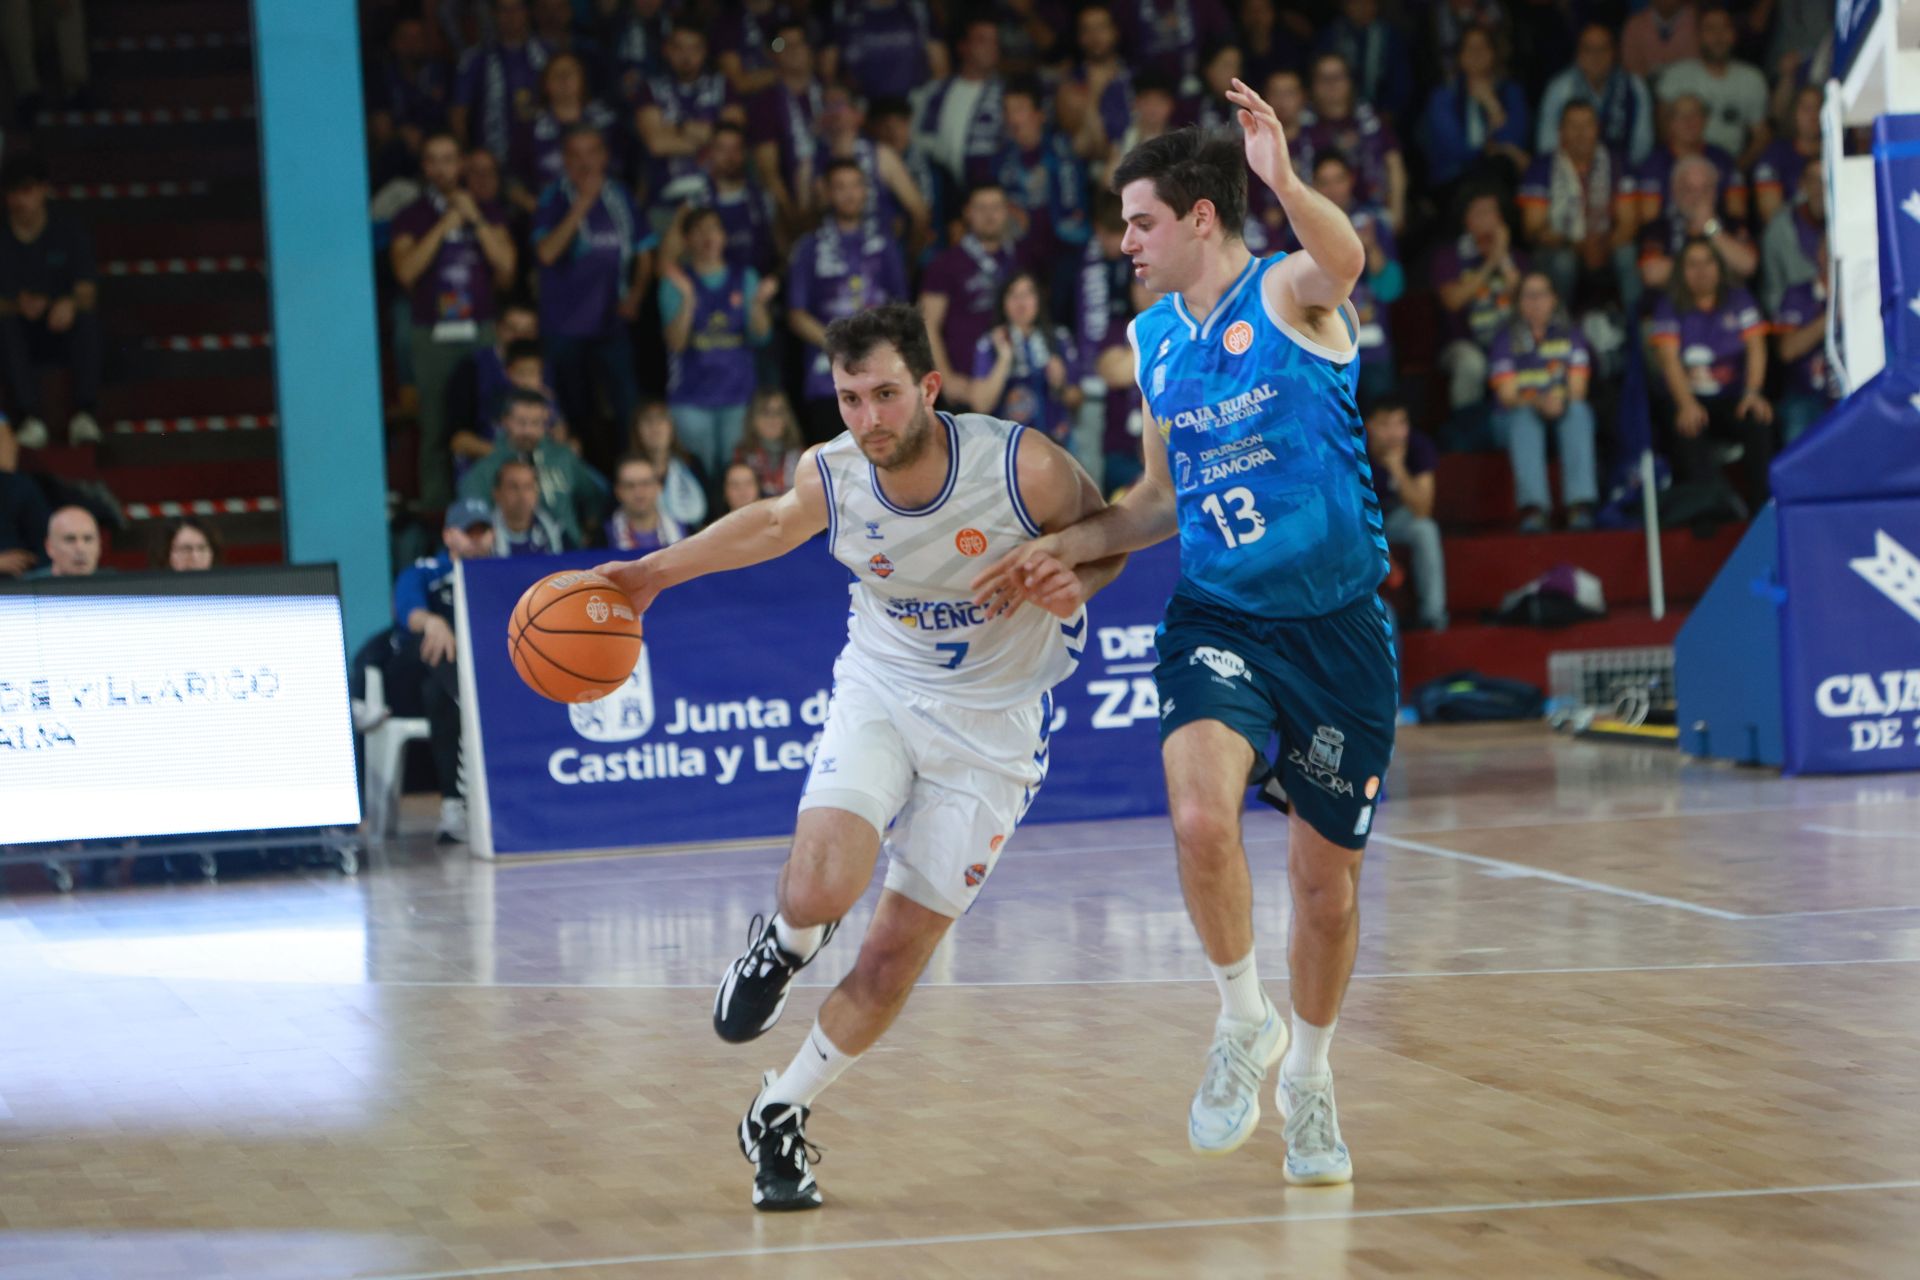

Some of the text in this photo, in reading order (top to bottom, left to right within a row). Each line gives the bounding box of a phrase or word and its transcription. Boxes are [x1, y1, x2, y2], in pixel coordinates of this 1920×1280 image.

[1175, 383, 1279, 429] CAJA RURAL
[1215, 404, 1263, 428] ZAMORA
[1201, 448, 1277, 485] ZAMORA
[1201, 486, 1267, 550] 13
[935, 642, 970, 670] 7
[664, 689, 830, 736] Junta d
[1849, 717, 1905, 752] DE
[548, 741, 707, 786] Castilla
[713, 745, 745, 785] y
